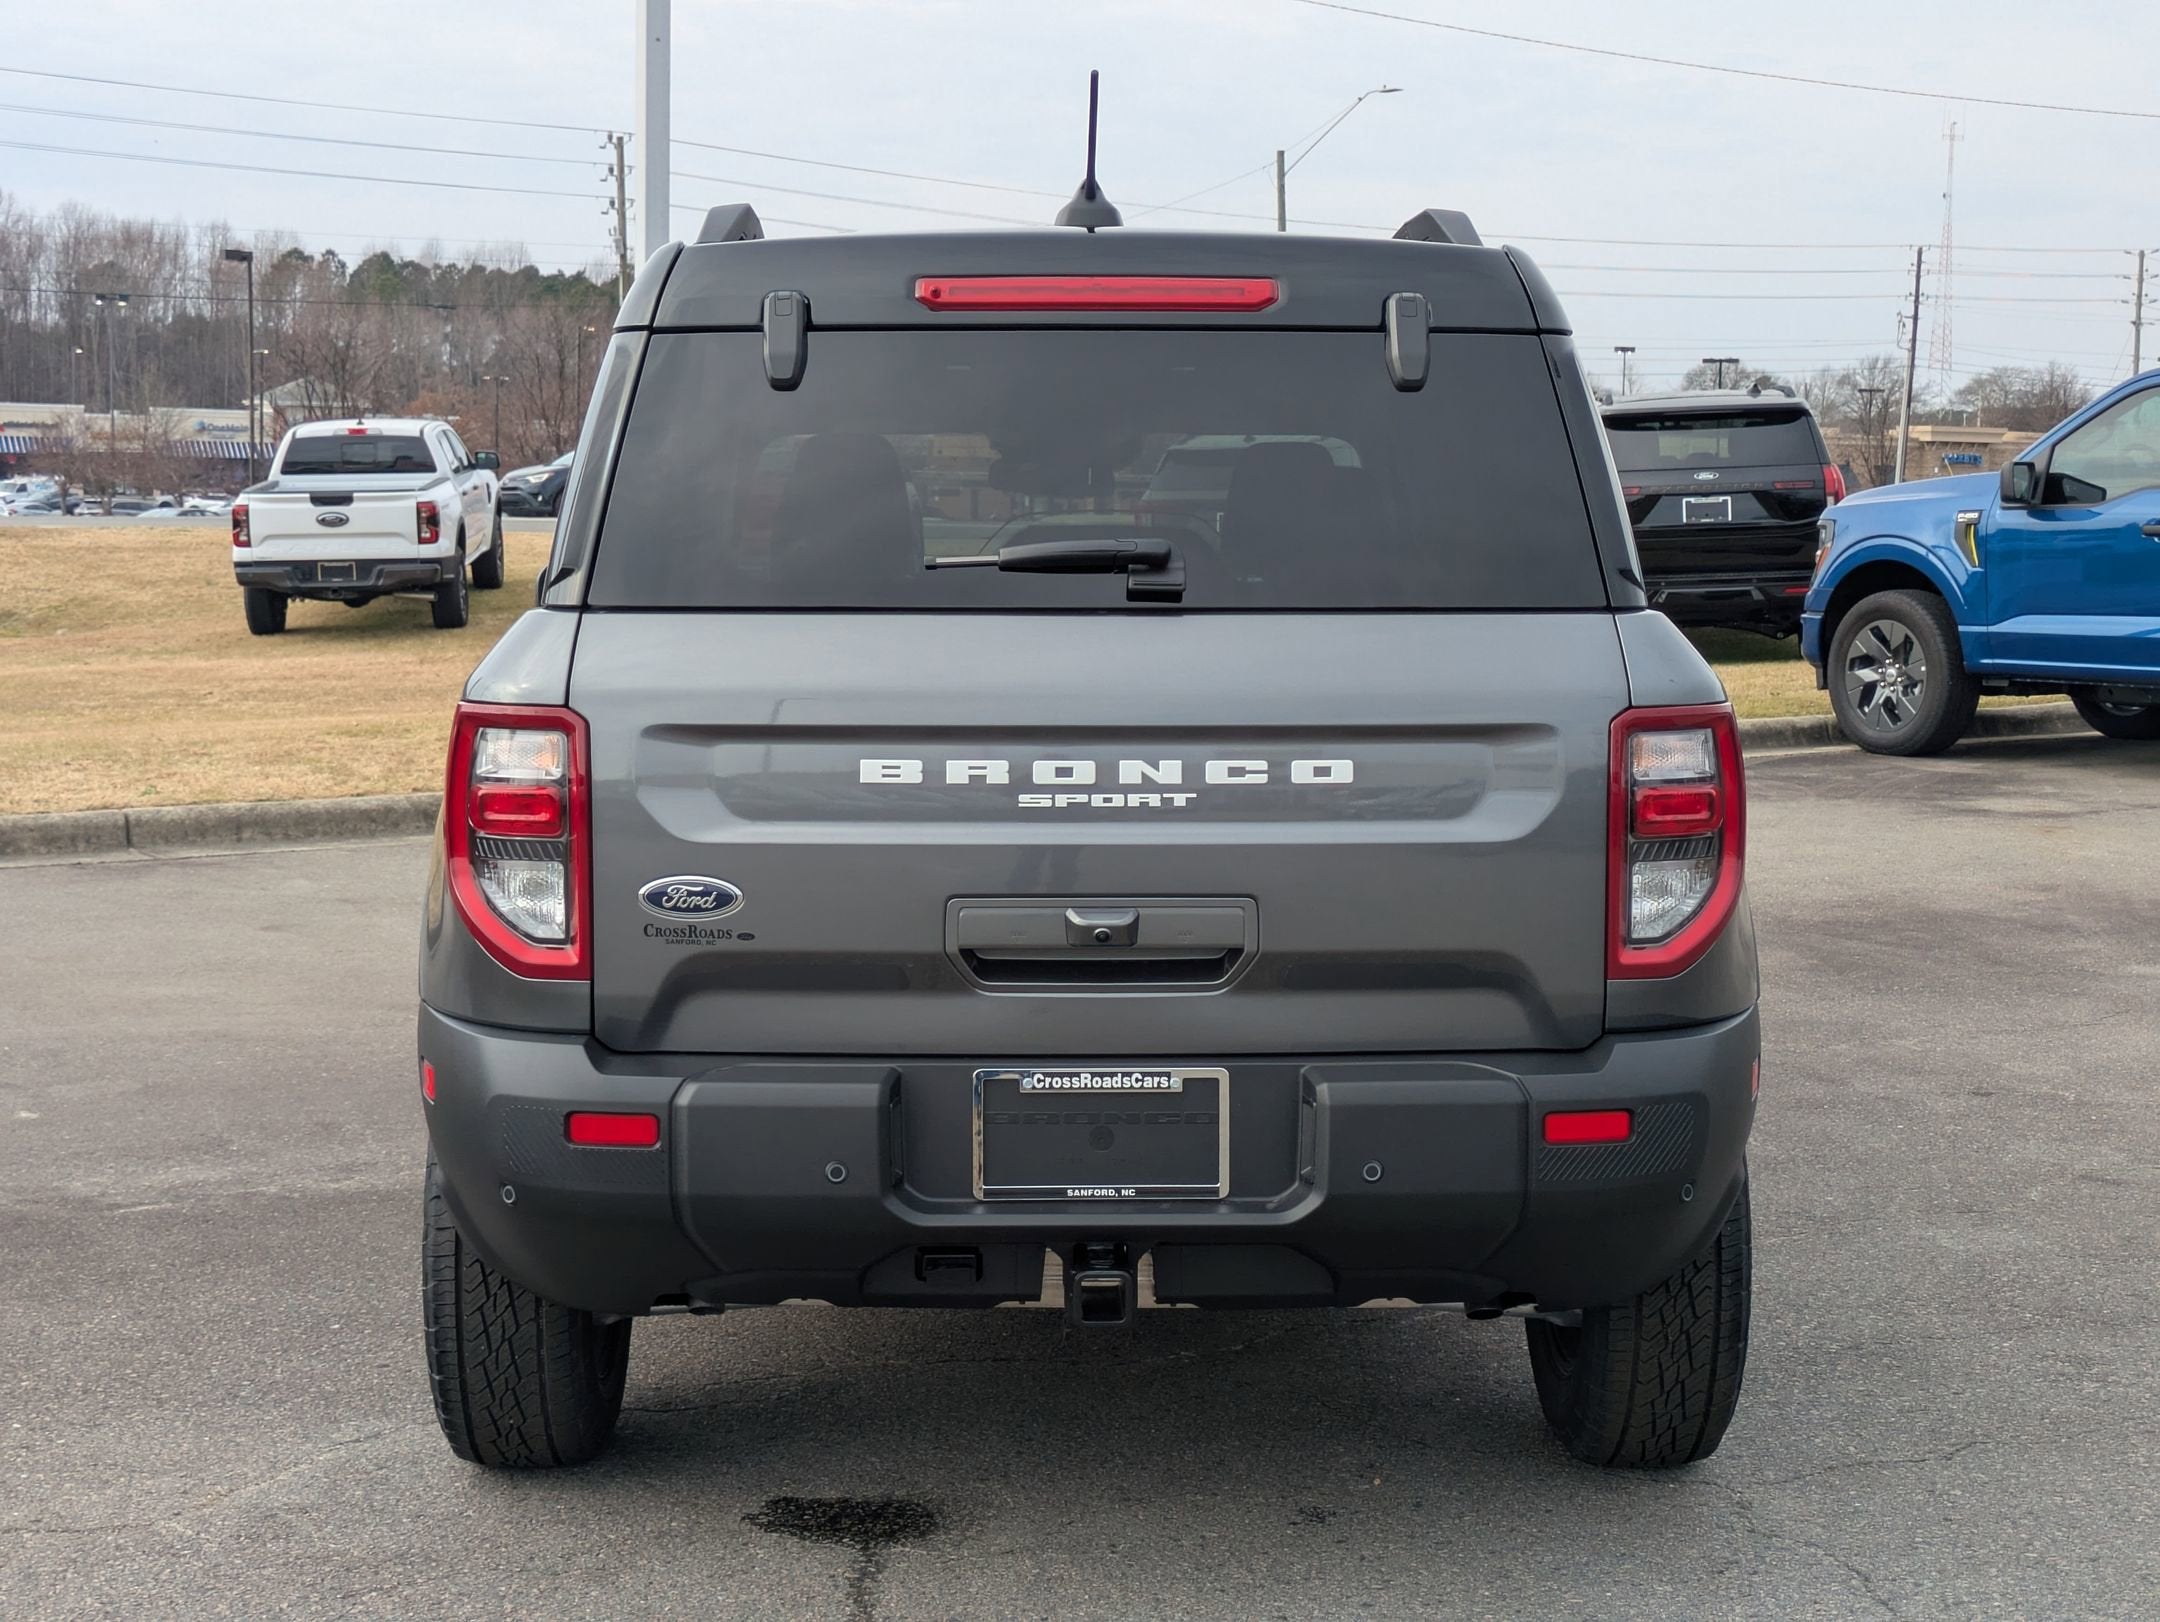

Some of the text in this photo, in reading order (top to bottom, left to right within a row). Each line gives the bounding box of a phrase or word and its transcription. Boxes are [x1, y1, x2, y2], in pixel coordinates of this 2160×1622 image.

[859, 758, 1355, 785] BRONCO
[1017, 793, 1198, 808] SPORT
[661, 884, 718, 909] Ford
[665, 938, 704, 946] SANFORD,
[1032, 1072, 1169, 1090] CrossRoadsCars
[985, 1111, 1219, 1126] BRONCO
[1066, 1188, 1137, 1197] SANFORD, NC
